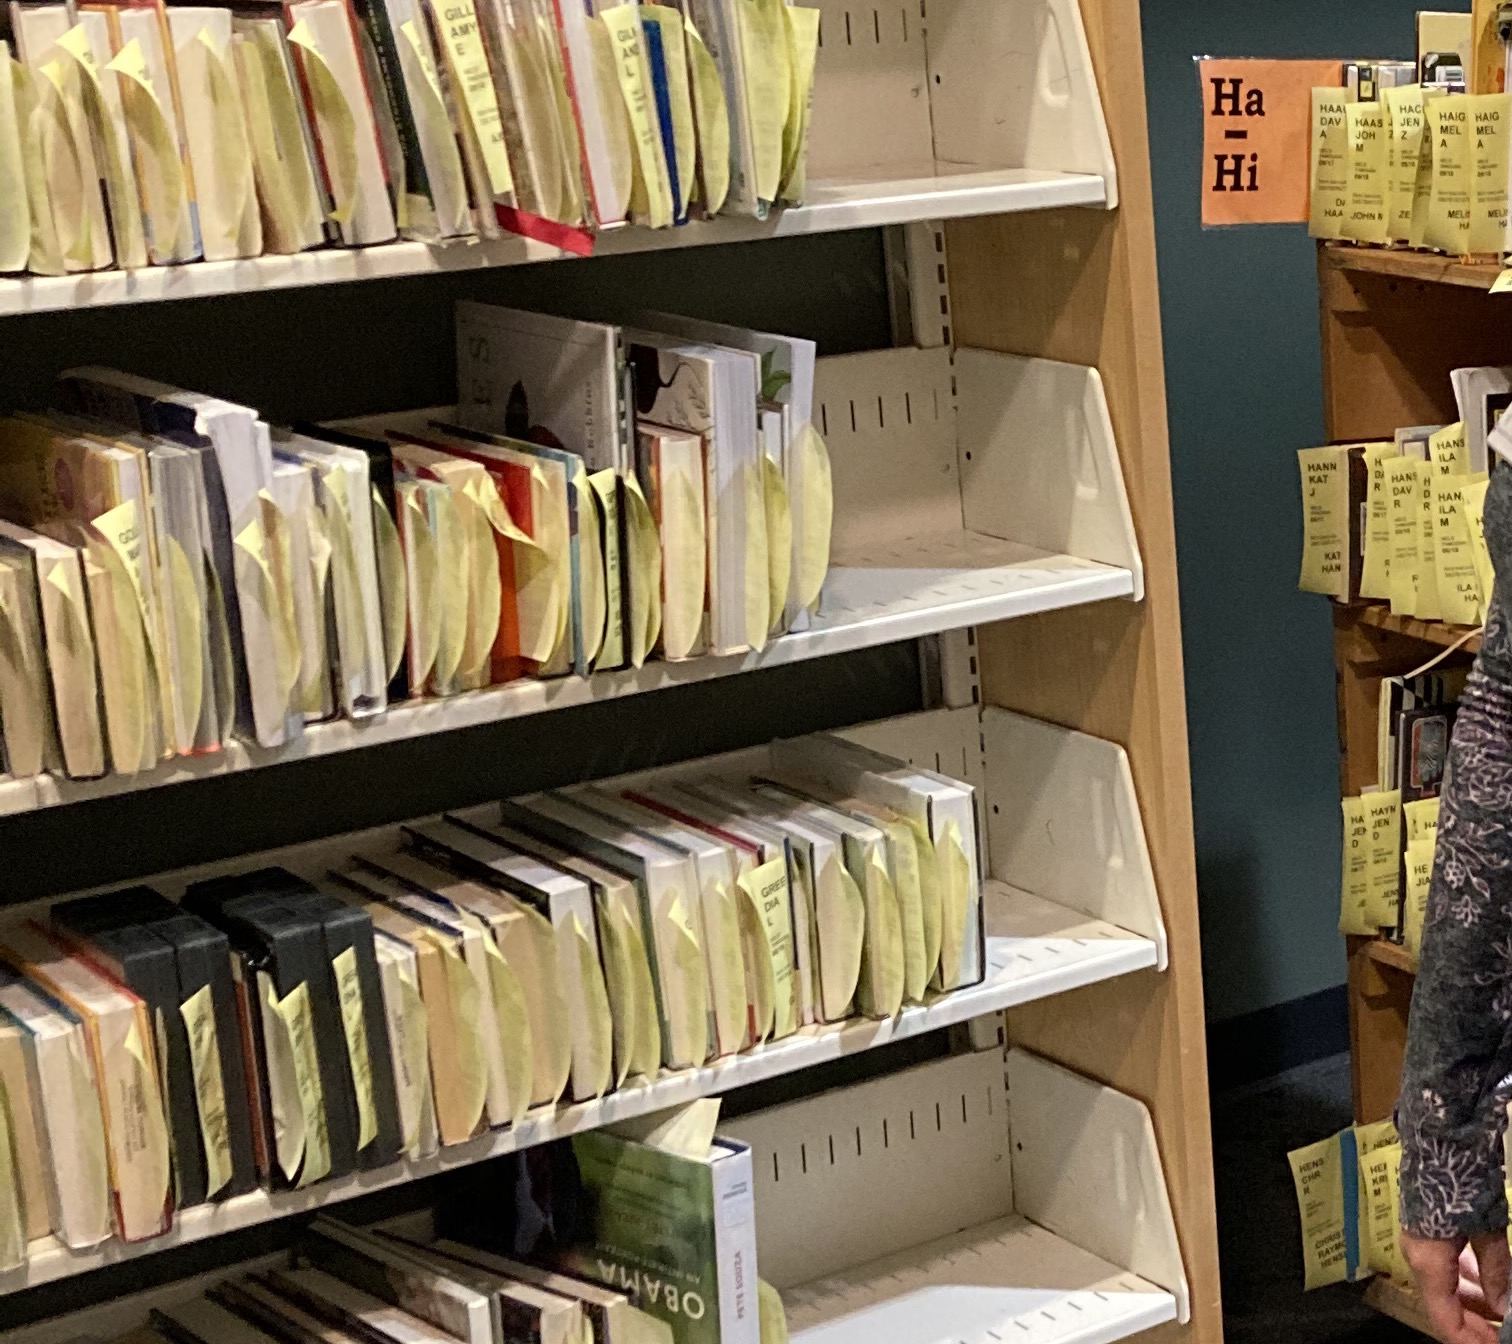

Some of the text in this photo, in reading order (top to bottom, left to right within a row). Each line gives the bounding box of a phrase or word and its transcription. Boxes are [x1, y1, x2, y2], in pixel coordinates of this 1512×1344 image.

[1210, 77, 1265, 118] Ha
[1400, 104, 1423, 114] HAC
[1440, 112, 1465, 122] HAIG
[1475, 111, 1499, 121] HAIG
[1320, 117, 1341, 126] DAV
[1355, 118, 1383, 128] HAAS
[1400, 118, 1420, 127] JEN
[1320, 130, 1327, 138] A
[1440, 125, 1461, 134] MEL
[1476, 126, 1496, 135] MEL
[1356, 131, 1376, 140] JOH
[1401, 131, 1407, 139] Z
[1356, 144, 1364, 152] M
[1440, 139, 1447, 148] A
[1477, 139, 1483, 148] A
[1212, 153, 1258, 192] Hi
[1437, 438, 1465, 450] HANS
[1439, 453, 1457, 463] ILA
[1308, 462, 1337, 472] HANN
[1441, 466, 1449, 475] M
[1309, 475, 1328, 484] KAT
[1374, 483, 1381, 491] R
[1392, 486, 1413, 496] DAV
[1310, 488, 1315, 497] J
[1438, 492, 1464, 502] HAN
[1394, 500, 1401, 508] R
[1439, 505, 1457, 515] ILA
[1440, 518, 1449, 527] M
[1372, 819, 1390, 829] JEN
[764, 897, 780, 913] DIA
[598, 1259, 705, 1320] OBAMA
